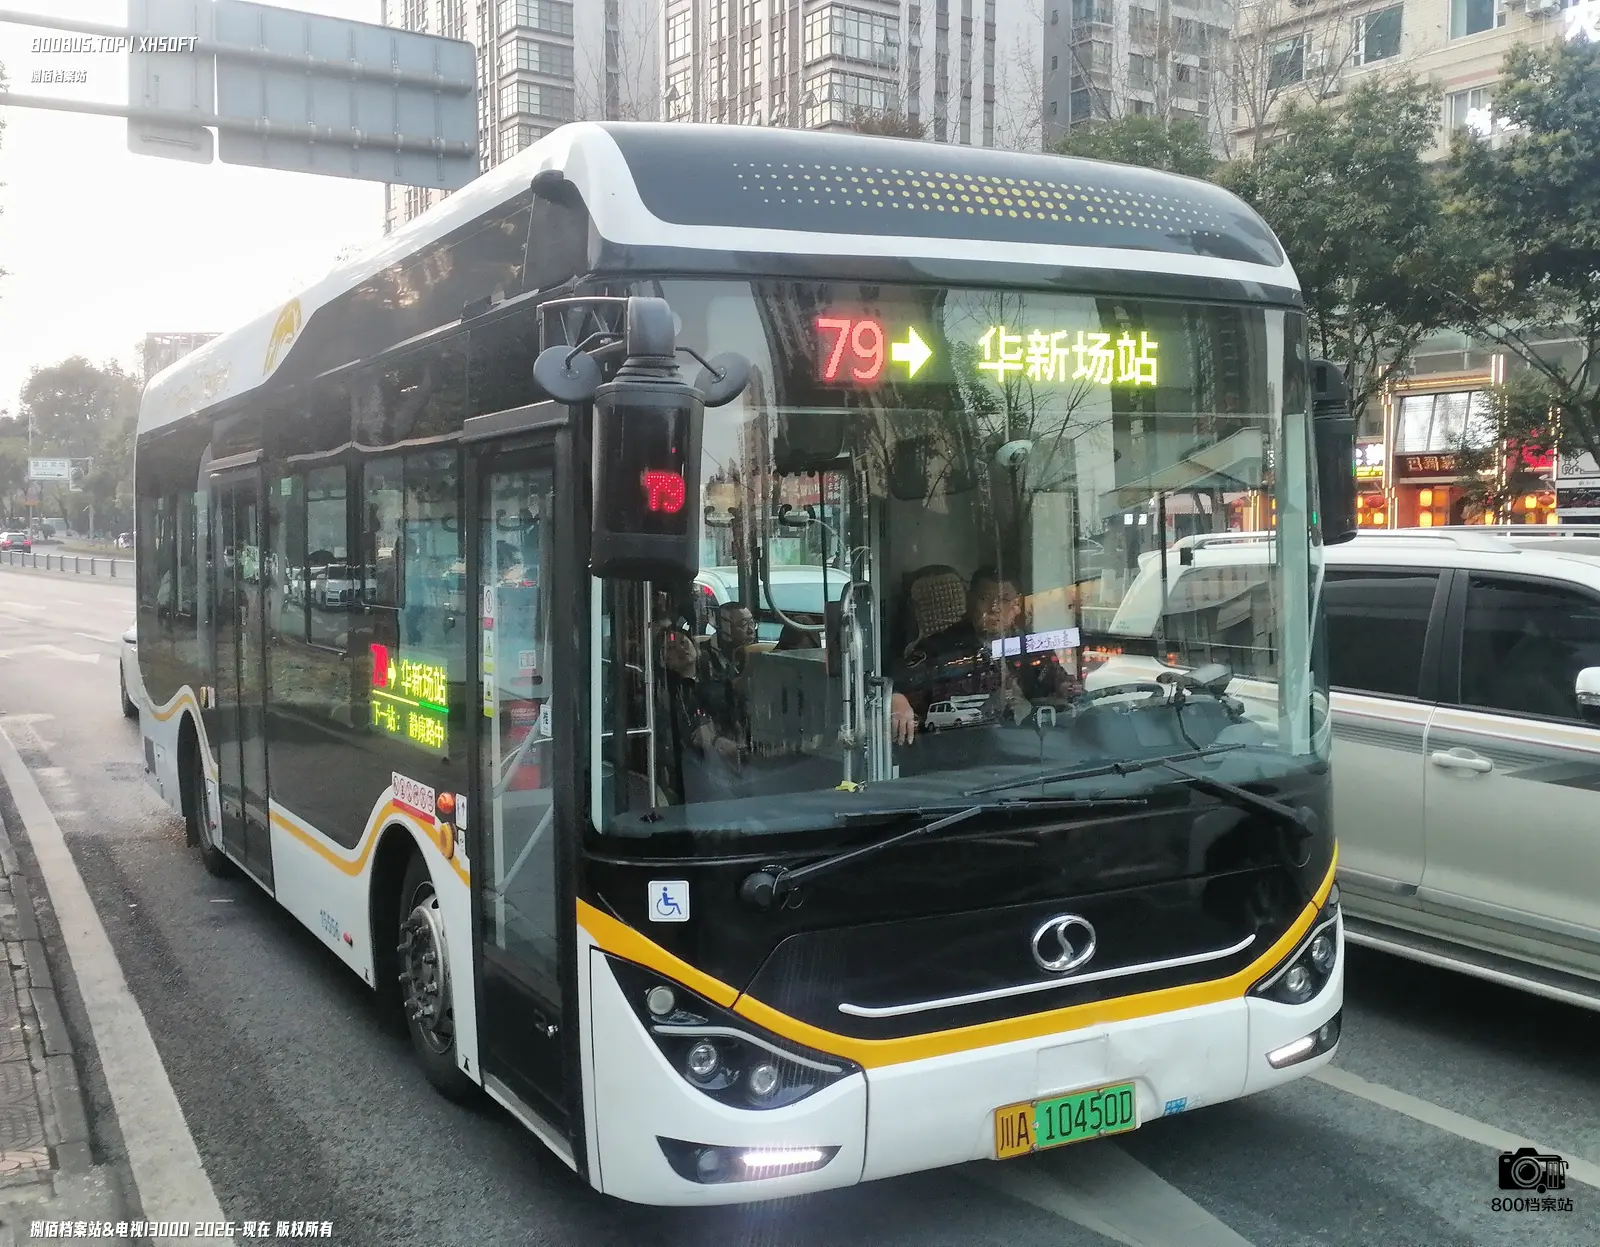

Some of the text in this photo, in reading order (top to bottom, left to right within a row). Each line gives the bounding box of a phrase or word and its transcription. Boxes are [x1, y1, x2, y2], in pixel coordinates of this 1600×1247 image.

[817, 318, 1159, 386] 79 华新场站
[643, 470, 686, 513] 79
[401, 658, 446, 707] 华新场站
[1000, 1090, 1133, 1151] 川A 10450D
